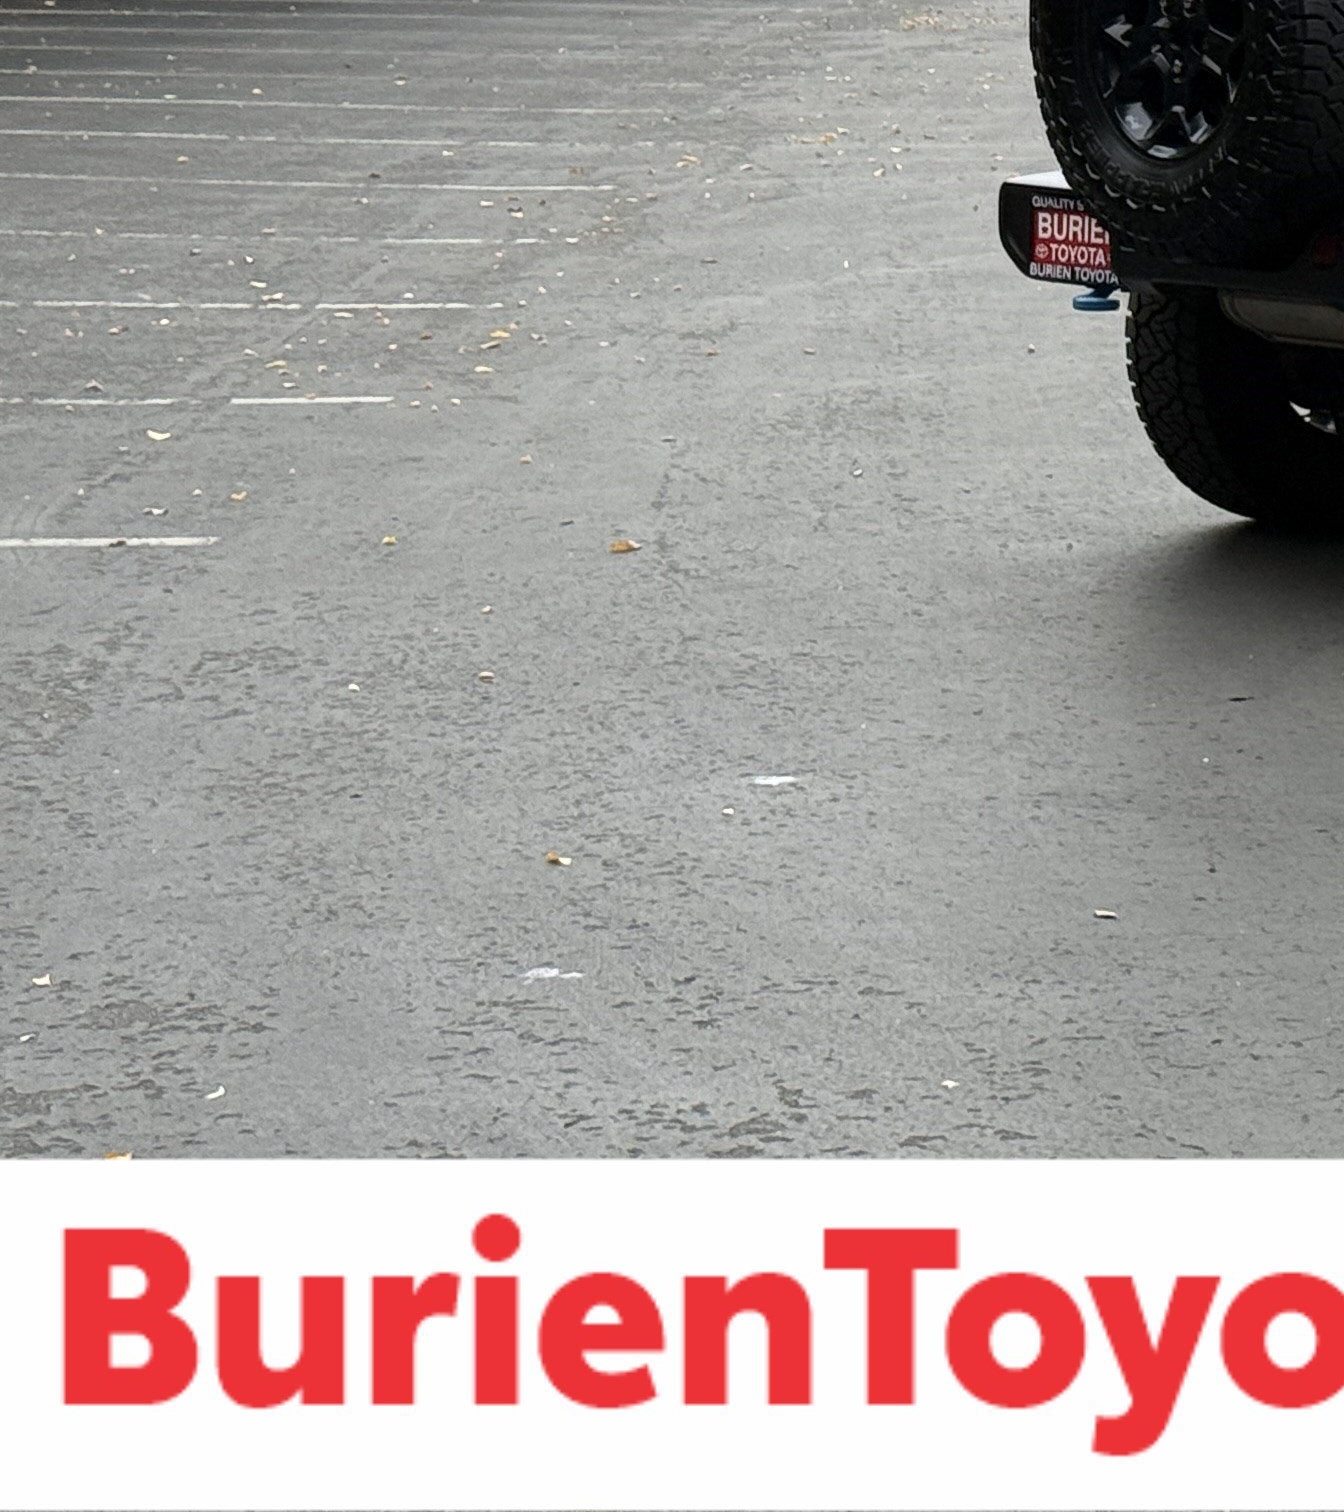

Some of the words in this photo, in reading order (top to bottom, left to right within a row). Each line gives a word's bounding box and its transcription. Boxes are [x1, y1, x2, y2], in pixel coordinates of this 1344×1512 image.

[1032, 195, 1074, 210] QUALITY
[1050, 243, 1106, 266] TOYOTA
[1030, 262, 1071, 279] BURIEN
[1074, 267, 1119, 285] TOYOTA
